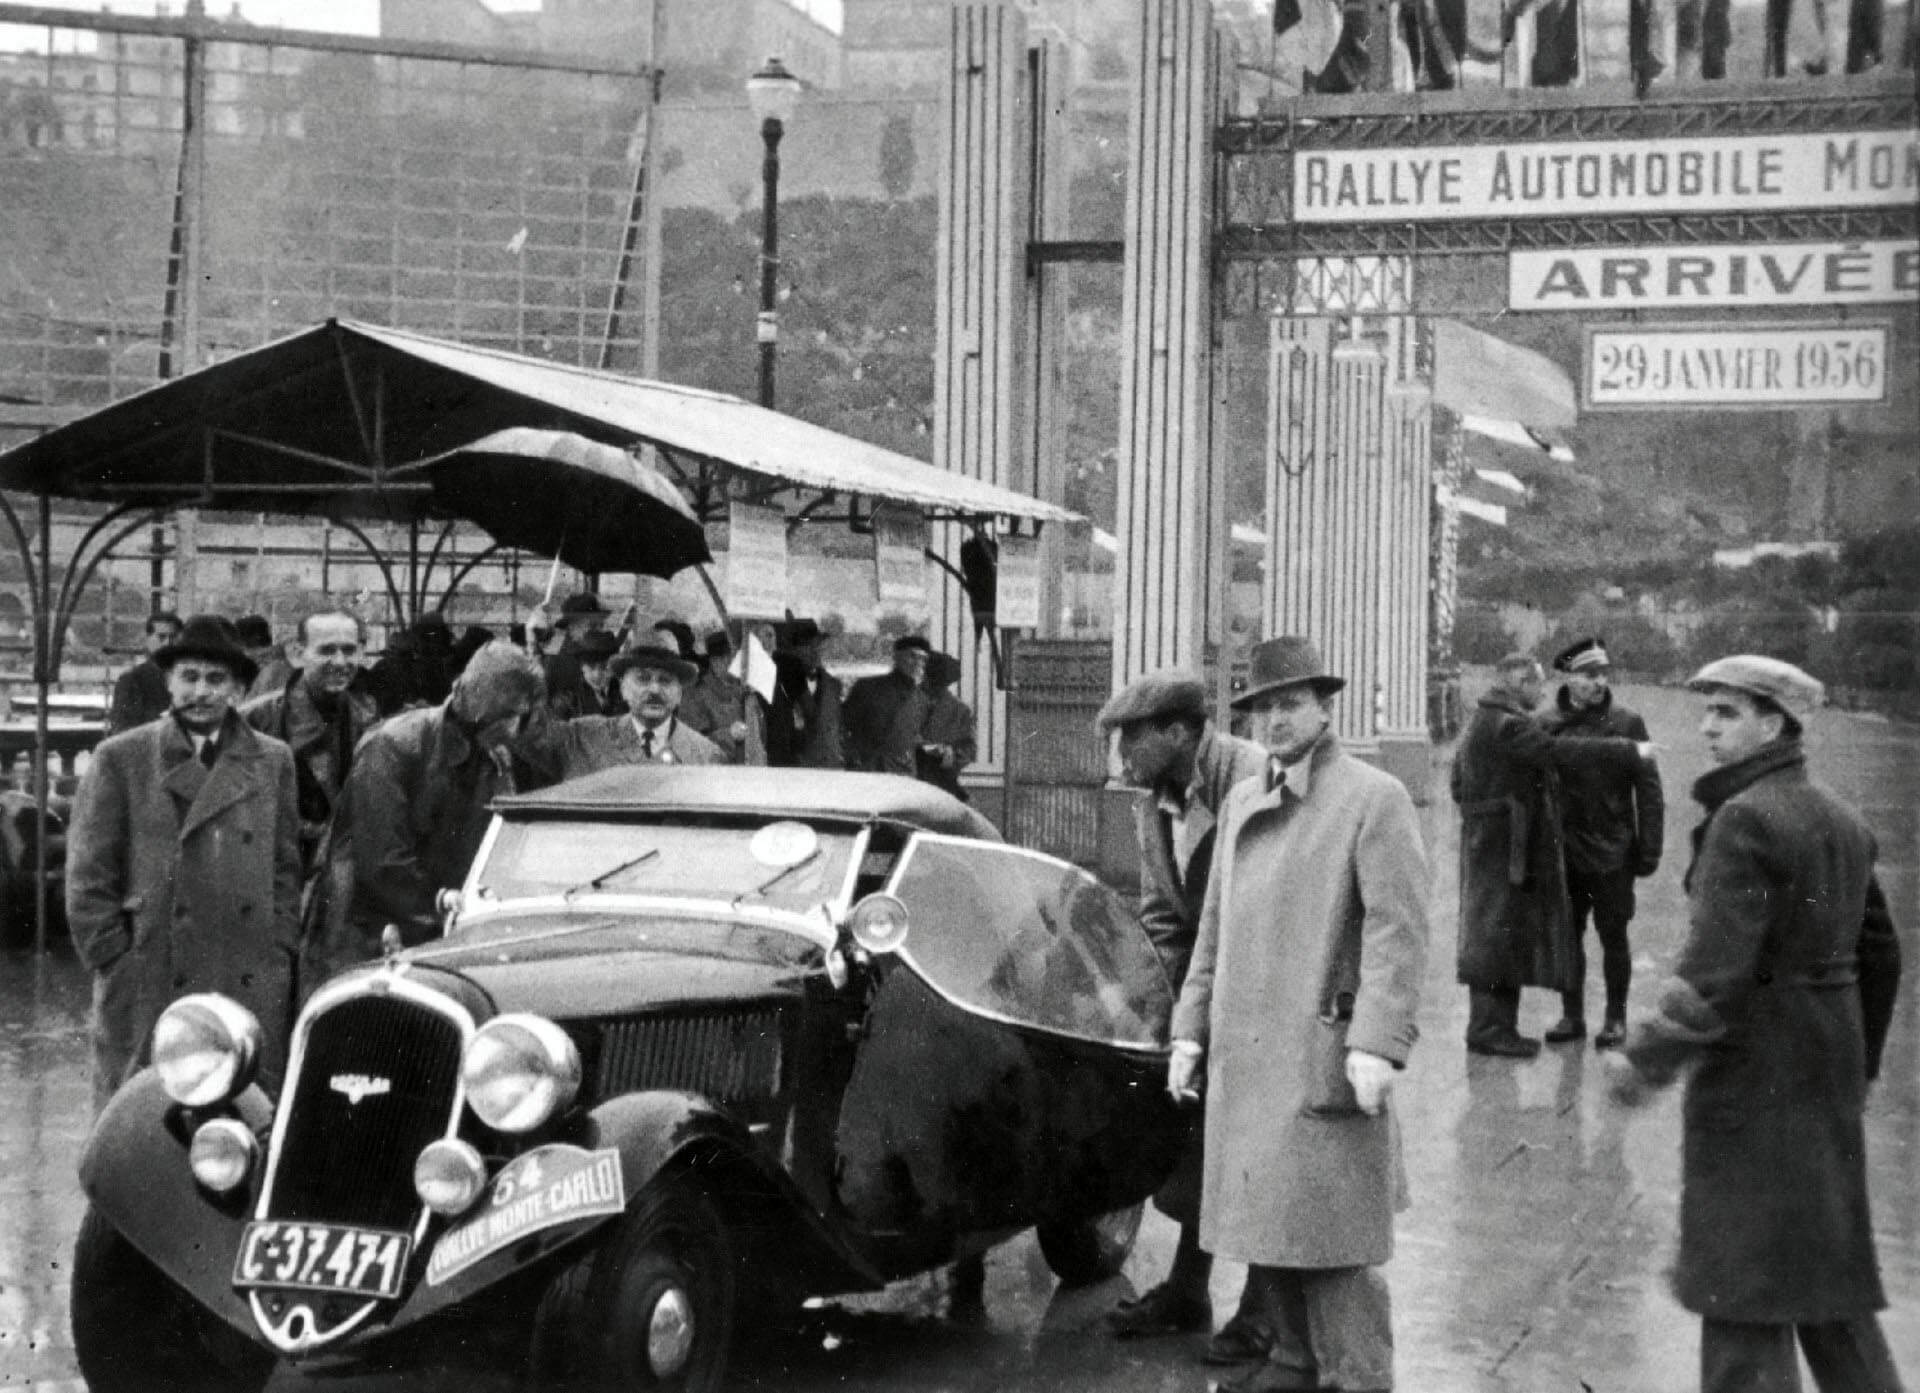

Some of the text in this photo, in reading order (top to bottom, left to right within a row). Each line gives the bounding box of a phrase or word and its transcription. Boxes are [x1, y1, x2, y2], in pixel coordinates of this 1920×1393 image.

[1307, 157, 1461, 207] RALLYE
[1490, 148, 1782, 201] AUTOMOBILE
[1600, 343, 1647, 390] 29
[1653, 347, 1783, 391] JANVIER
